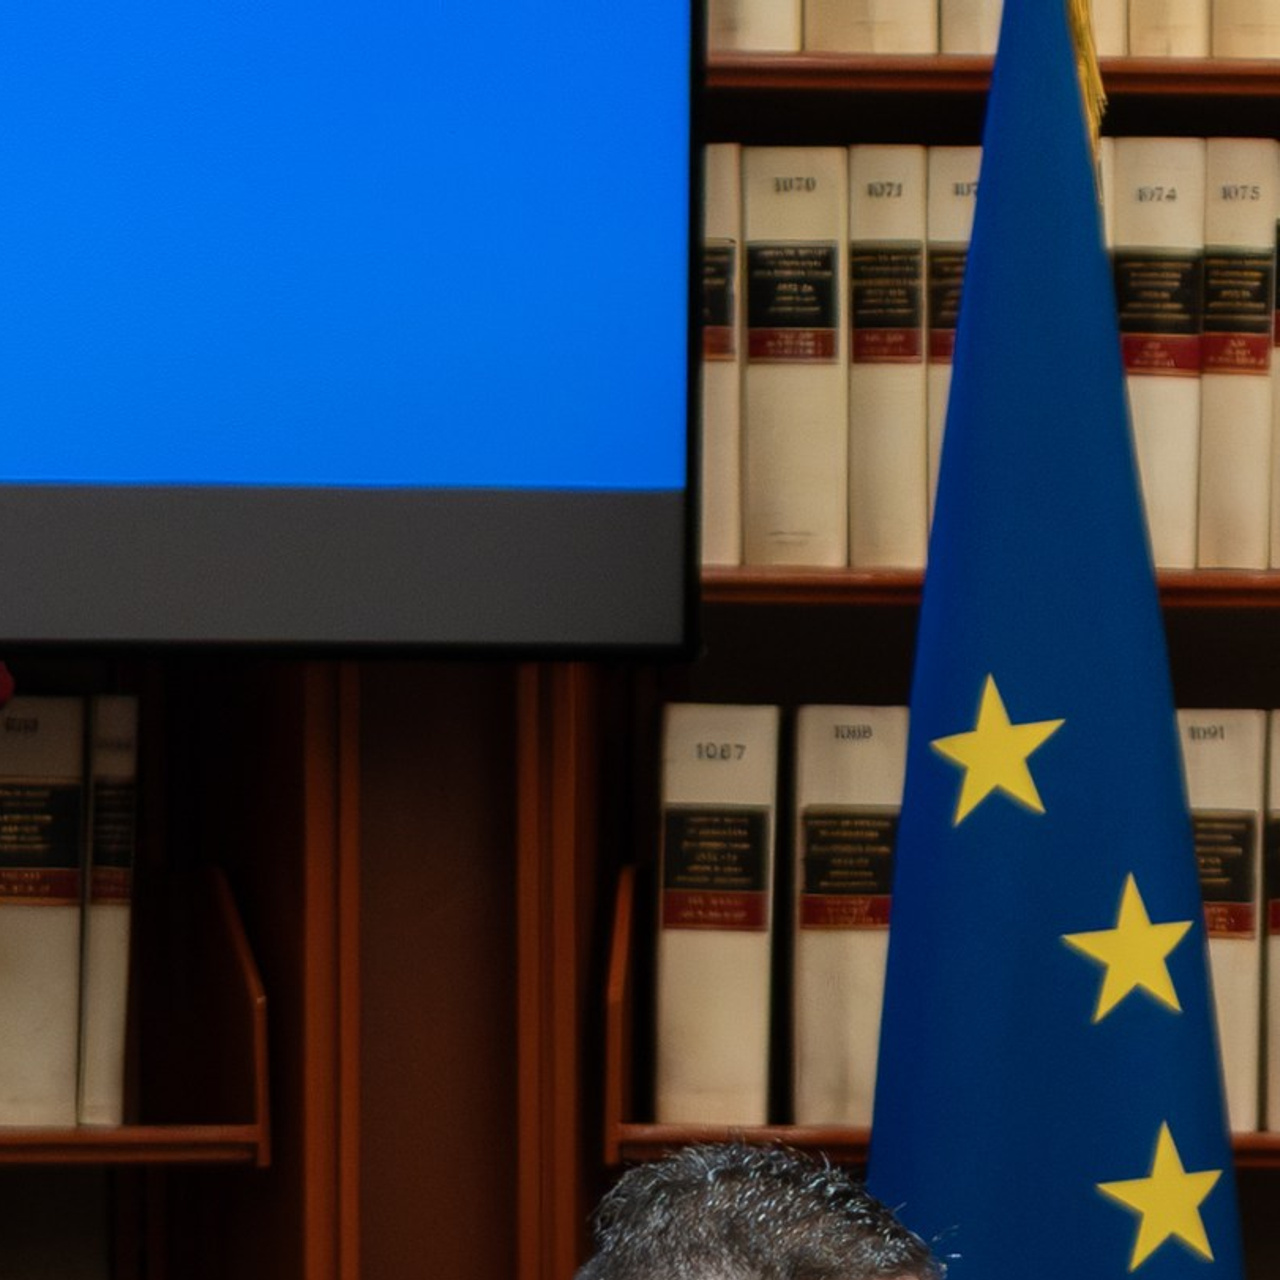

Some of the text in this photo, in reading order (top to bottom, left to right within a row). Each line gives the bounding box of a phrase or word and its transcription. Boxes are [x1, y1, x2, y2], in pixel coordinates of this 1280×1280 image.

[773, 177, 816, 193] 1070
[866, 182, 903, 198] 1071
[953, 182, 978, 197] 107
[1221, 185, 1260, 200] 1075
[1137, 187, 1177, 202] 1074
[695, 743, 746, 760] 1087
